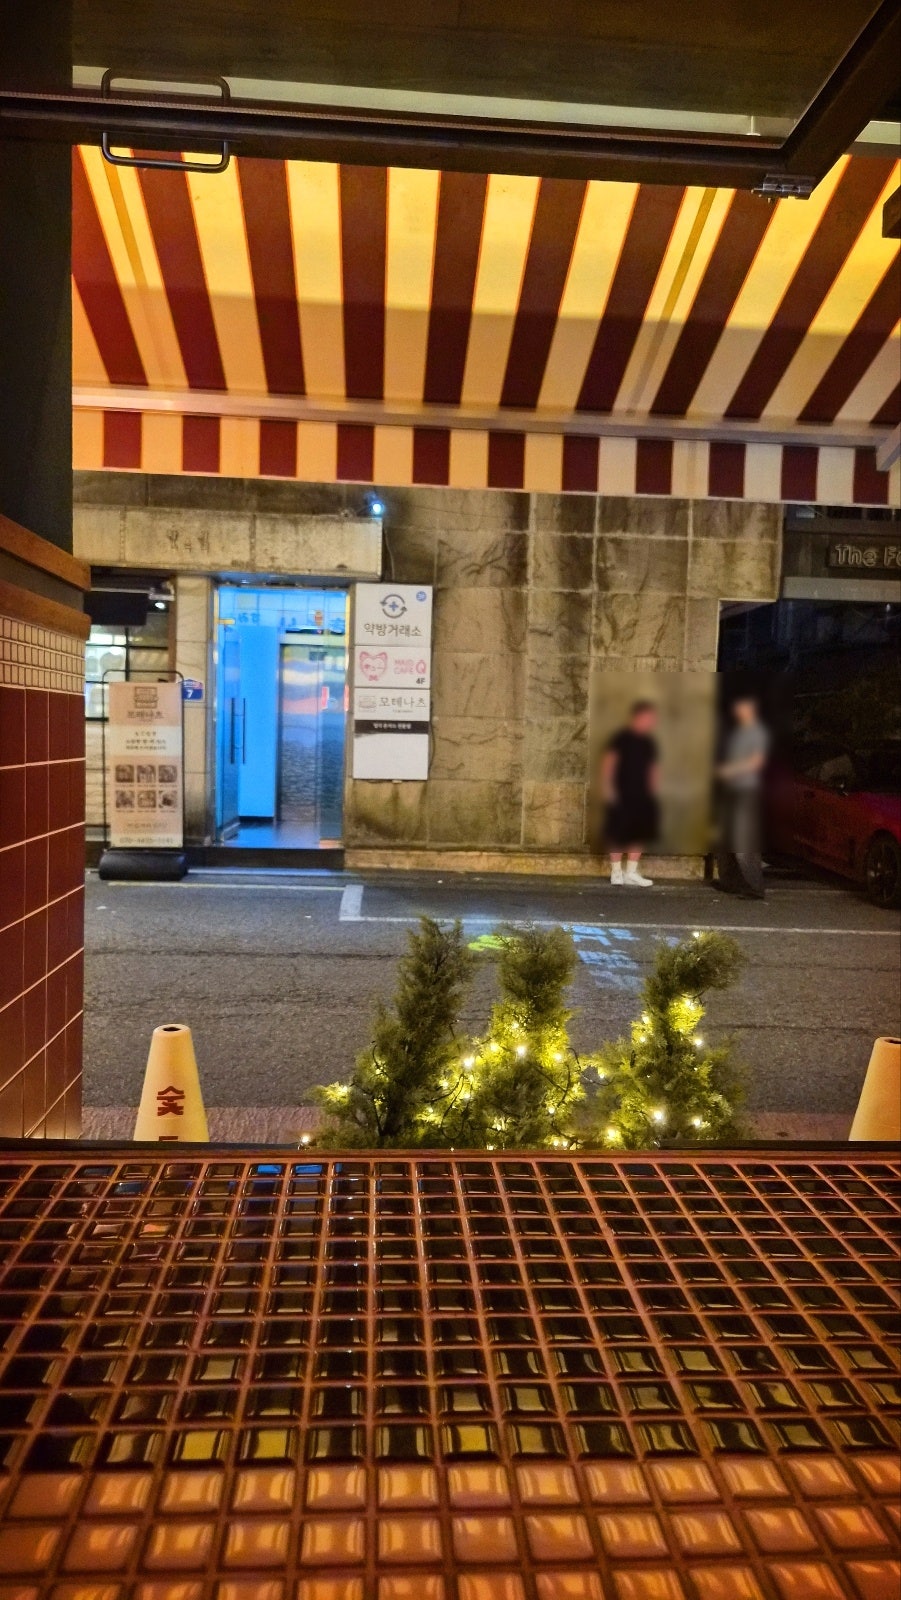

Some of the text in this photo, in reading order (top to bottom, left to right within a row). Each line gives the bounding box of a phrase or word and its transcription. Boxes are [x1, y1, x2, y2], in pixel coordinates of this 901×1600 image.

[835, 545, 876, 567] The
[364, 623, 422, 637] 약방거래소
[416, 659, 427, 675] Q
[416, 677, 426, 685] 4F
[186, 689, 194, 699] 7
[379, 696, 427, 708] 모테나츠
